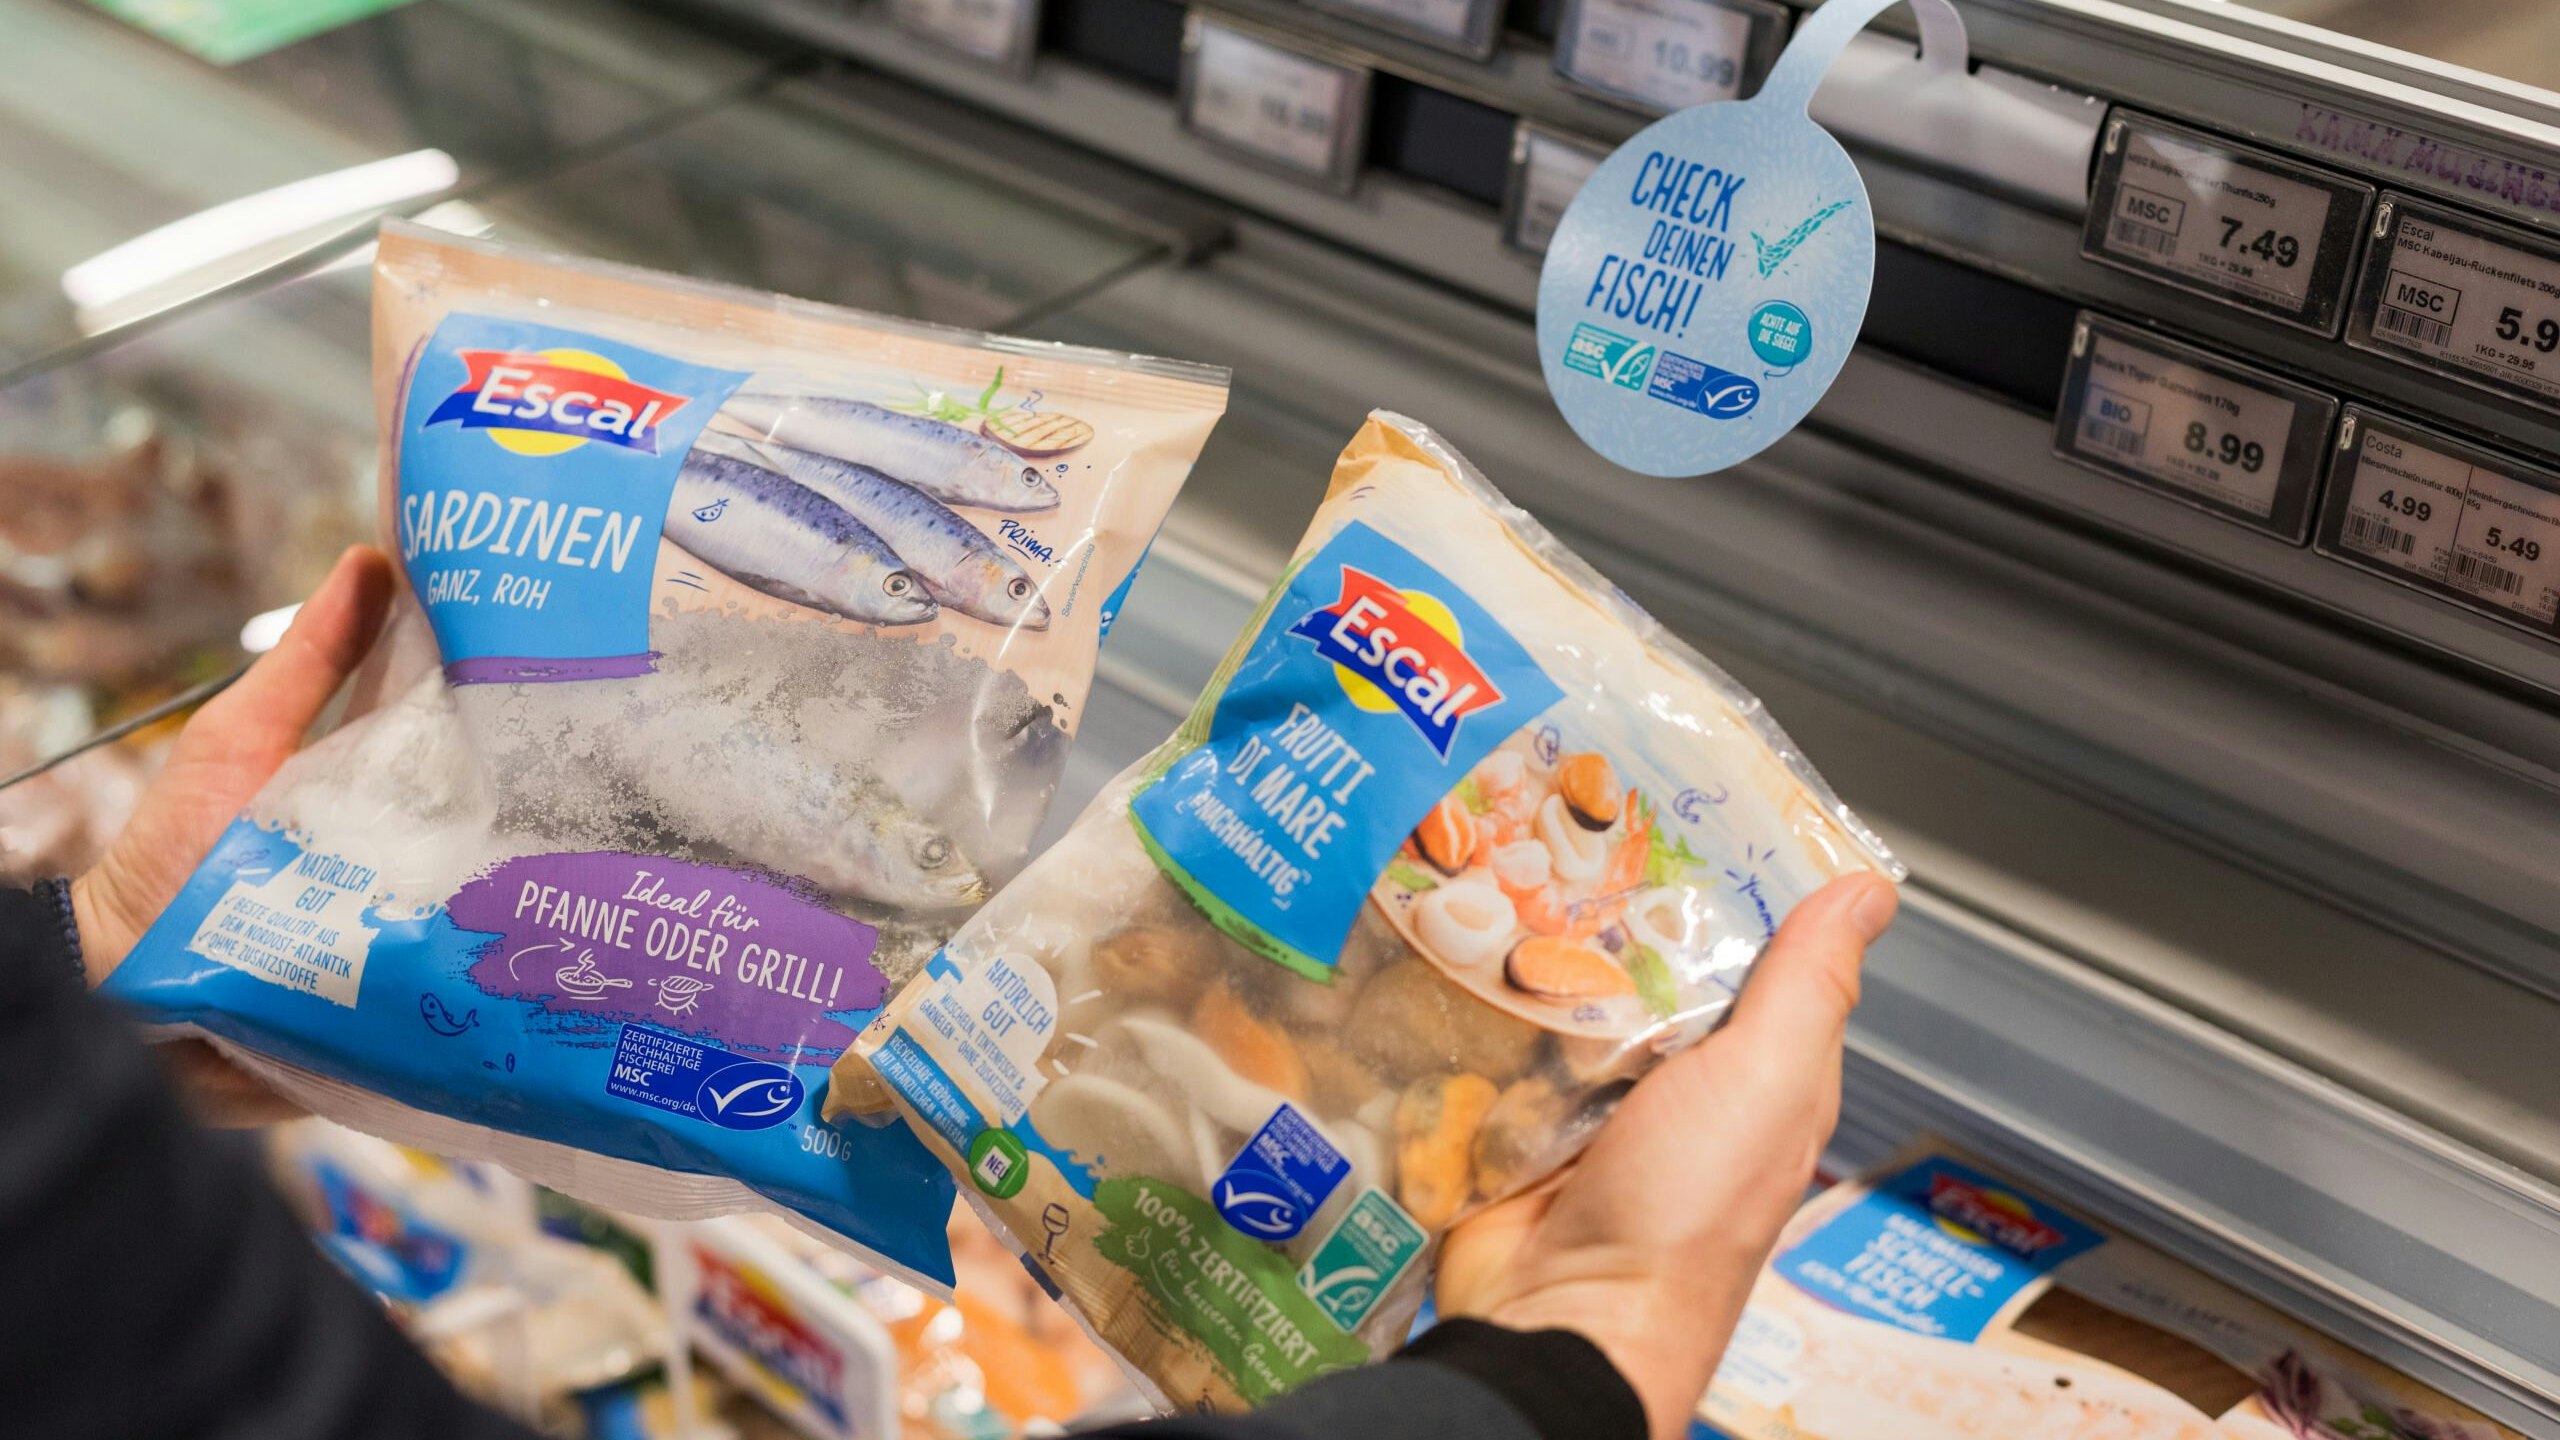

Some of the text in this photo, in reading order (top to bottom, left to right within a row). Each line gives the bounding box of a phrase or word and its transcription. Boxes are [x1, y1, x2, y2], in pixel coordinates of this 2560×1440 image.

[1630, 151, 1745, 233] CHECK
[2127, 197, 2171, 225] MSC
[1643, 221, 1736, 282] DEINEN
[2219, 216, 2300, 268] 7.49
[2398, 238, 2422, 252] MSC
[2401, 221, 2435, 242] Escal
[1585, 254, 1704, 339] FISCH!
[2397, 283, 2445, 314] MSC
[2474, 343, 2496, 358] 1KG
[2495, 305, 2560, 355] 5.9
[472, 366, 663, 440] Escal
[2101, 398, 2132, 424] BIO
[2183, 420, 2265, 475] 8.99
[2365, 434, 2403, 459] Costa
[2378, 489, 2432, 523] 4.99
[404, 489, 643, 574] SARDINEN
[2486, 526, 2541, 562] 5.49
[427, 568, 552, 611] GANZ, ROH
[1328, 595, 1478, 729] Escal
[1269, 701, 1377, 807] FRUTTI
[1226, 734, 1347, 861] DI MARE
[294, 850, 378, 894] NATÜRLICH
[232, 895, 341, 948] BESTE QUALITÄT AUS
[294, 885, 337, 916] GUT
[621, 869, 762, 935] Ideal für
[207, 932, 320, 991] OHNE ZUSATZSTOFFE
[218, 913, 353, 981] DEM NORDOST-ATLANTIK
[513, 879, 844, 1008] PFANNE ODER GRILL!
[981, 999, 1018, 1038] GUT
[984, 957, 1054, 1037] NATÜRLICH
[618, 1051, 676, 1076] FISCHEREI
[620, 1040, 702, 1071] NACHHALTIGE
[624, 1029, 704, 1060] ZERTIFIZIERTE
[875, 1048, 898, 1074] MIT
[918, 998, 953, 1041] GARNELEN
[956, 1040, 978, 1069] OHNE
[975, 1061, 1026, 1118] ZUSATZSTOFFE
[970, 1030, 1021, 1088] TINTENFISCH
[610, 1081, 697, 1114] www.msc.org/de
[613, 1064, 654, 1088] MSC
[985, 1154, 1011, 1181] NEU
[1131, 1186, 1195, 1248] 100%
[1188, 1235, 1320, 1369] ZERTIFIZIERT
[1182, 1278, 1243, 1344] besseren
[1240, 1341, 1286, 1393] Genu
